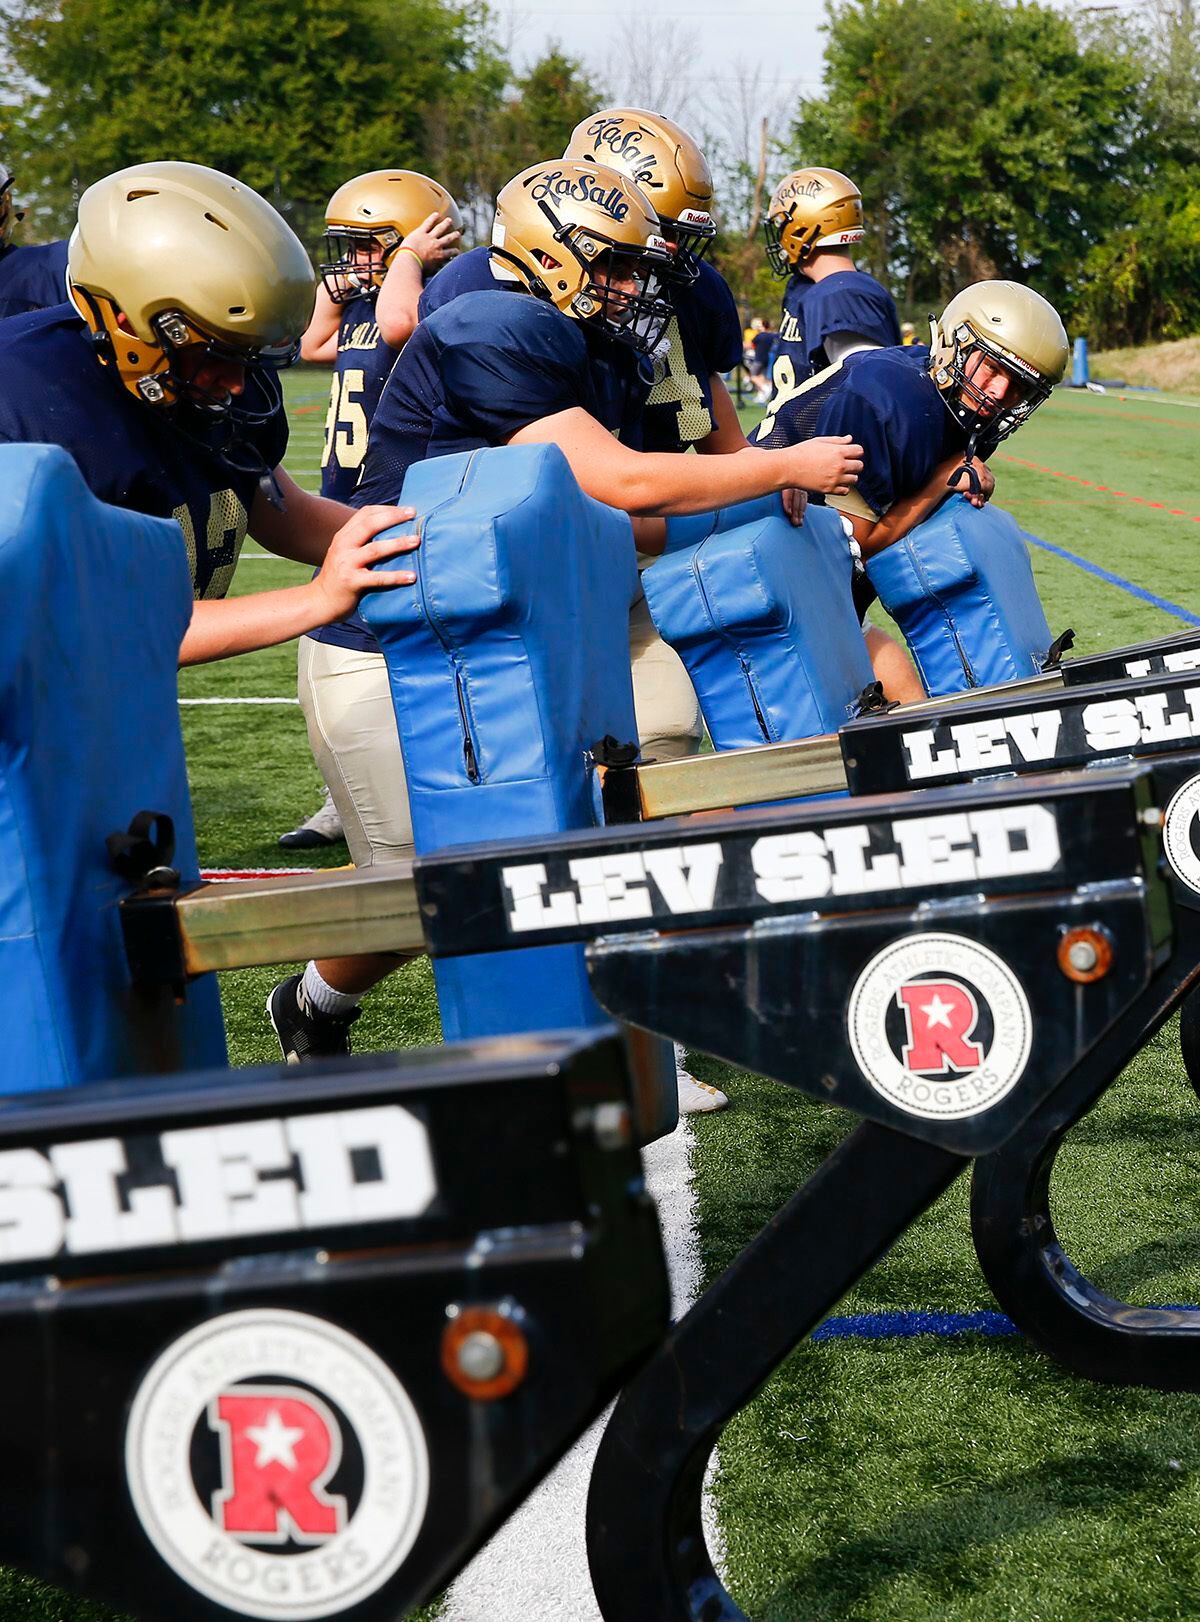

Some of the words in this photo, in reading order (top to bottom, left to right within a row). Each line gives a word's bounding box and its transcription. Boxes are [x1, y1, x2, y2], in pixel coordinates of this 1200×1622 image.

[587, 118, 663, 188] LaSalle
[532, 171, 630, 223] LaSalle
[903, 710, 1062, 780] LEV
[502, 842, 725, 933] LEV
[750, 803, 1062, 903] SLED
[1174, 806, 1191, 861] ROGERS
[864, 987, 887, 1062] ROGERS
[883, 949, 963, 988] ATHLETIC
[967, 961, 1018, 1054] COMPANY
[899, 981, 982, 1072] R
[896, 1066, 999, 1106] ROGERS
[214, 1393, 340, 1537] R
[202, 1538, 370, 1597] ROGERS
